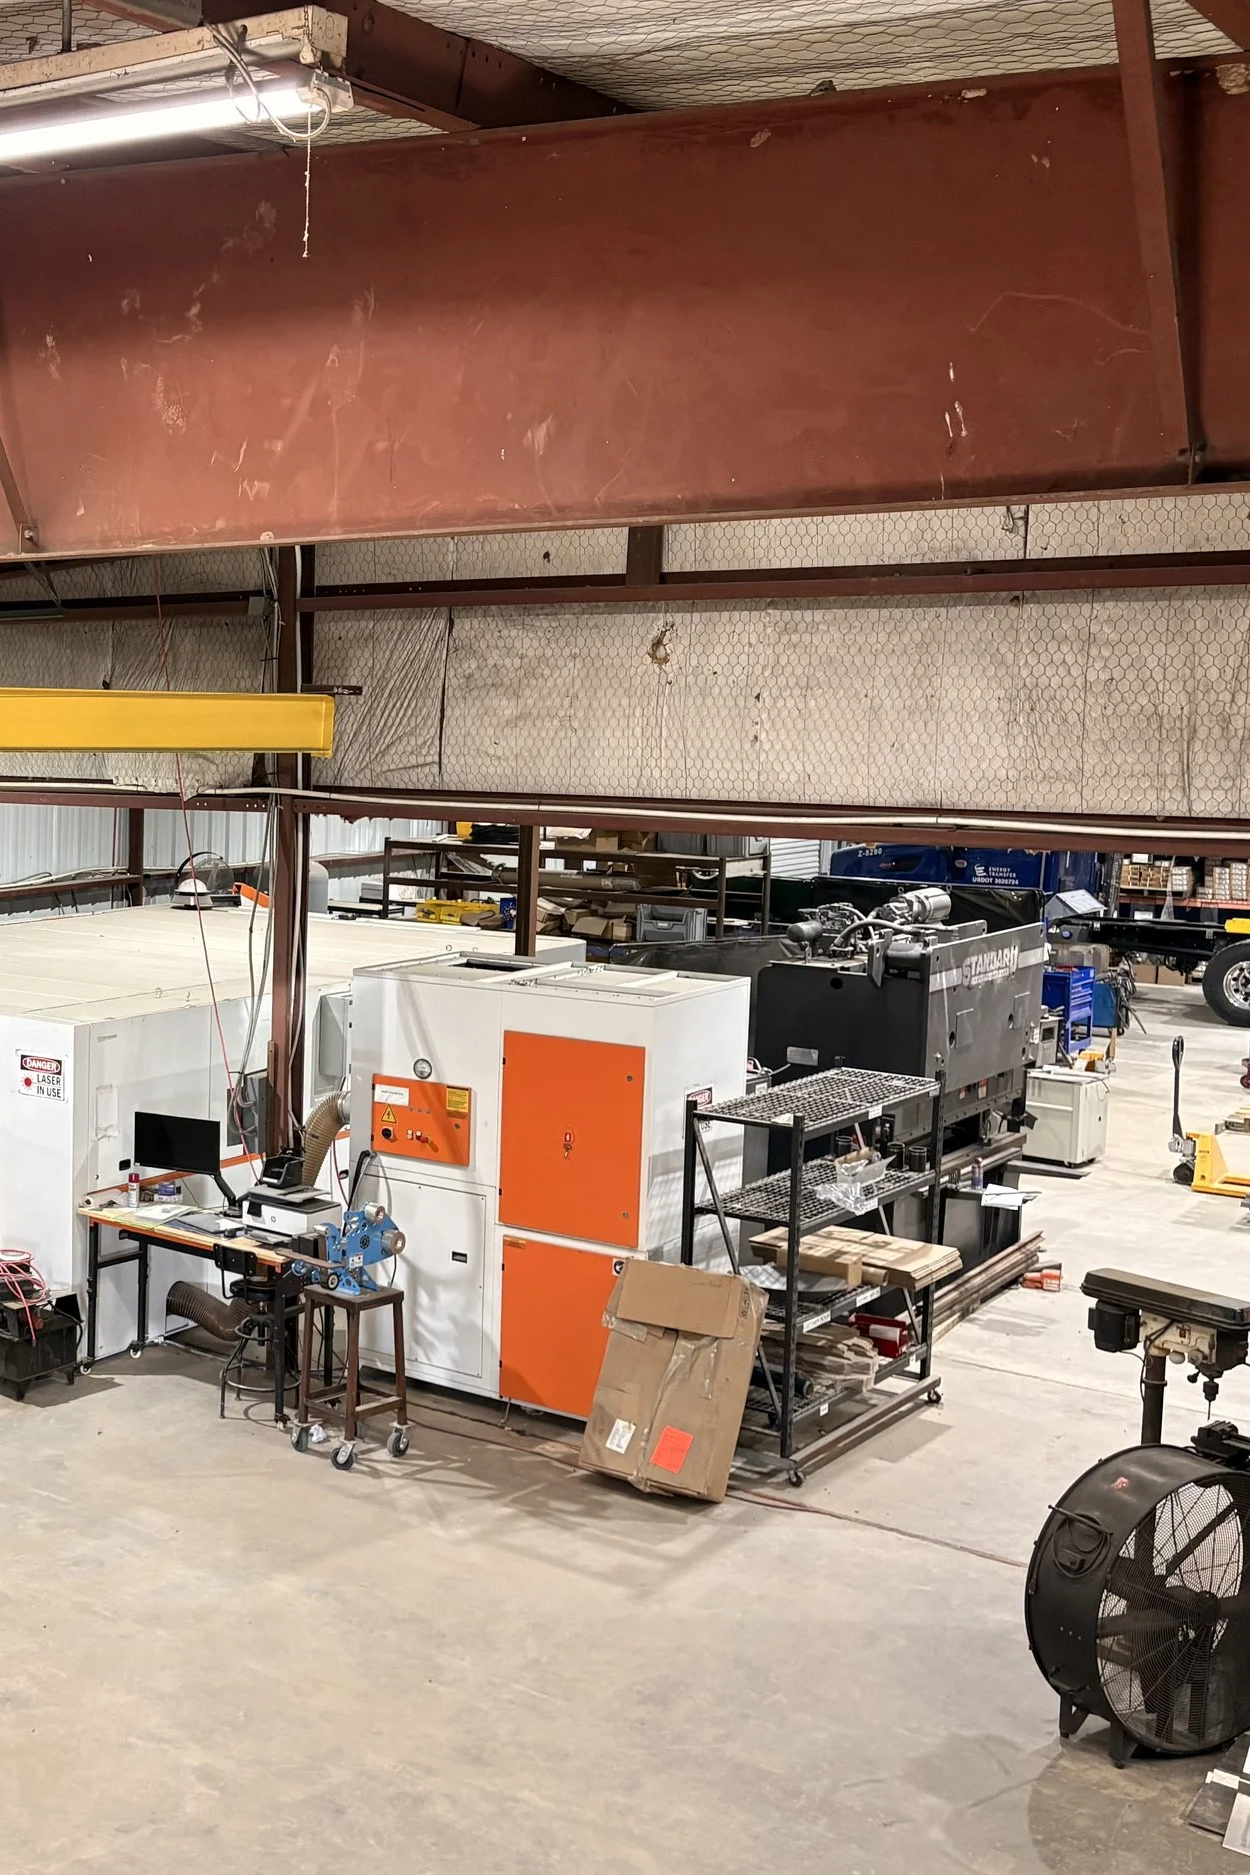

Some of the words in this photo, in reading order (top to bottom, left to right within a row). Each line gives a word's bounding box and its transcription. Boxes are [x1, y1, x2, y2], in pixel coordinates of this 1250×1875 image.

[972, 876, 994, 884] USDOT
[27, 1059, 56, 1071] DANGER
[37, 1074, 60, 1086] LASER
[37, 1086, 44, 1095] IN
[47, 1087, 61, 1098] USE
